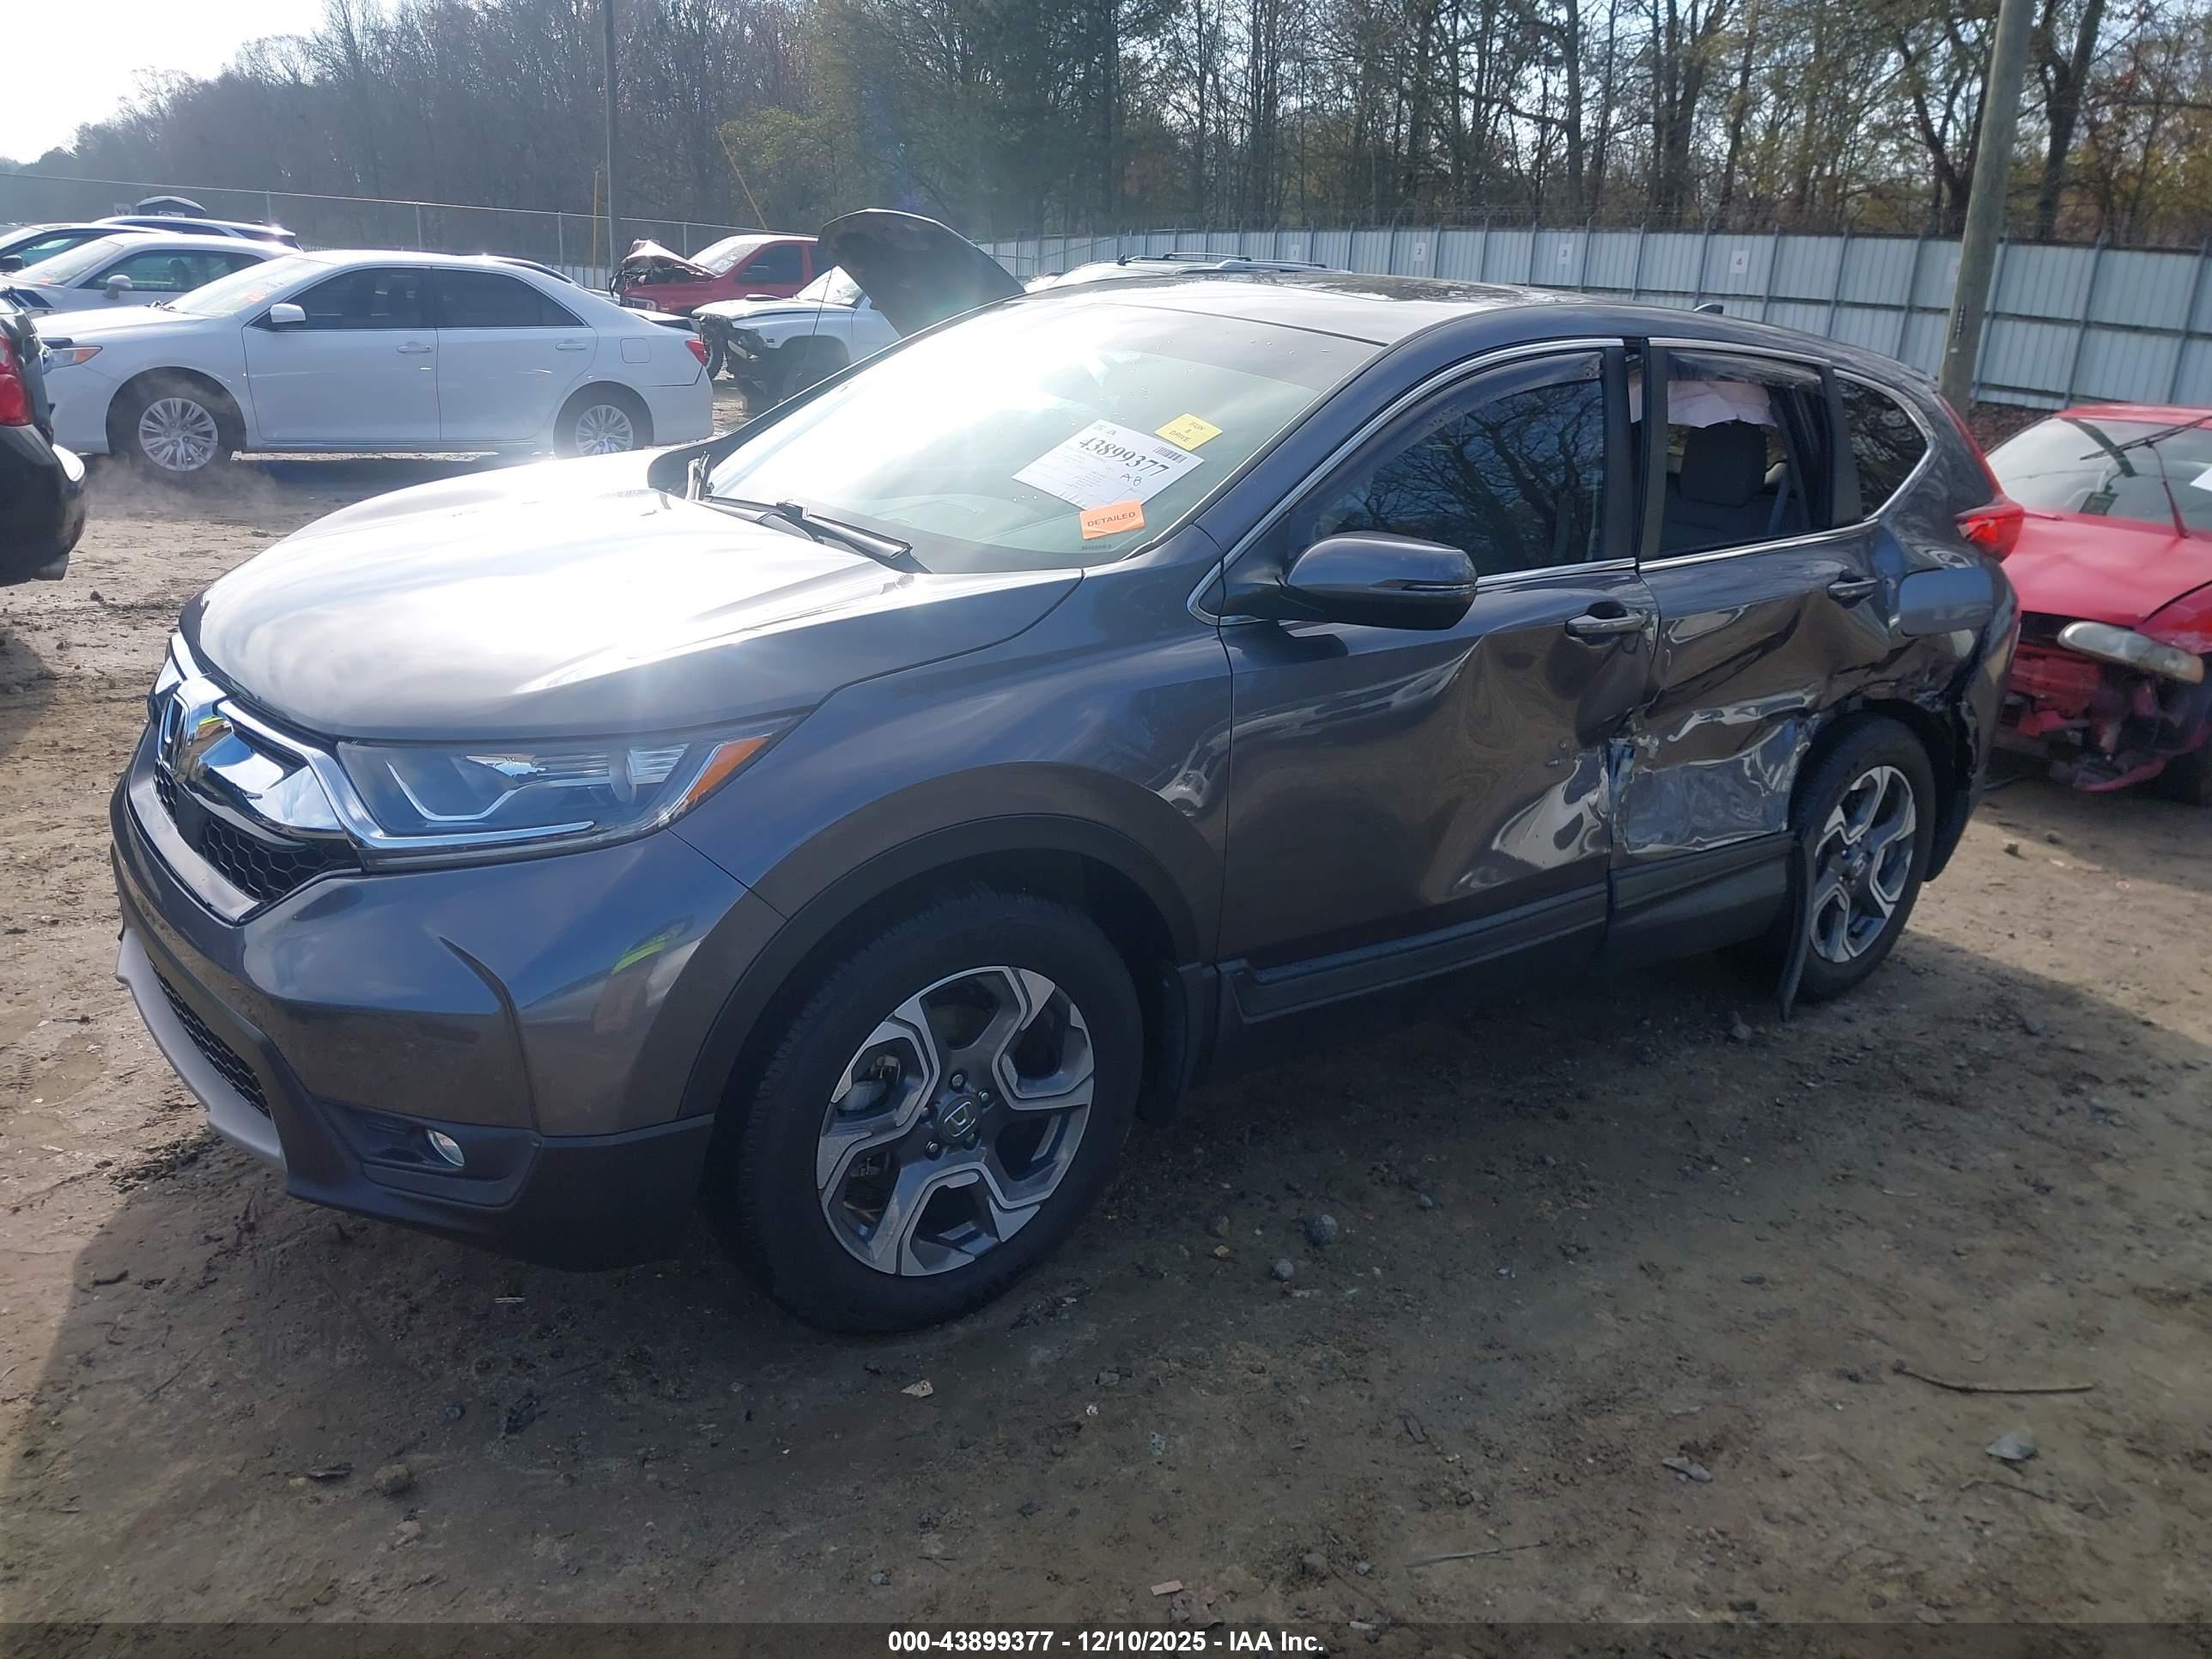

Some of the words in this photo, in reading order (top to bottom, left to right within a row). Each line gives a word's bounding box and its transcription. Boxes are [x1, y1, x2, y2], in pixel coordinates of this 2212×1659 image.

[1188, 421, 1206, 431] RUN
[1169, 429, 1191, 442] DRIVE
[1079, 437, 1170, 477] 43899377
[1086, 512, 1136, 526] DETAILED
